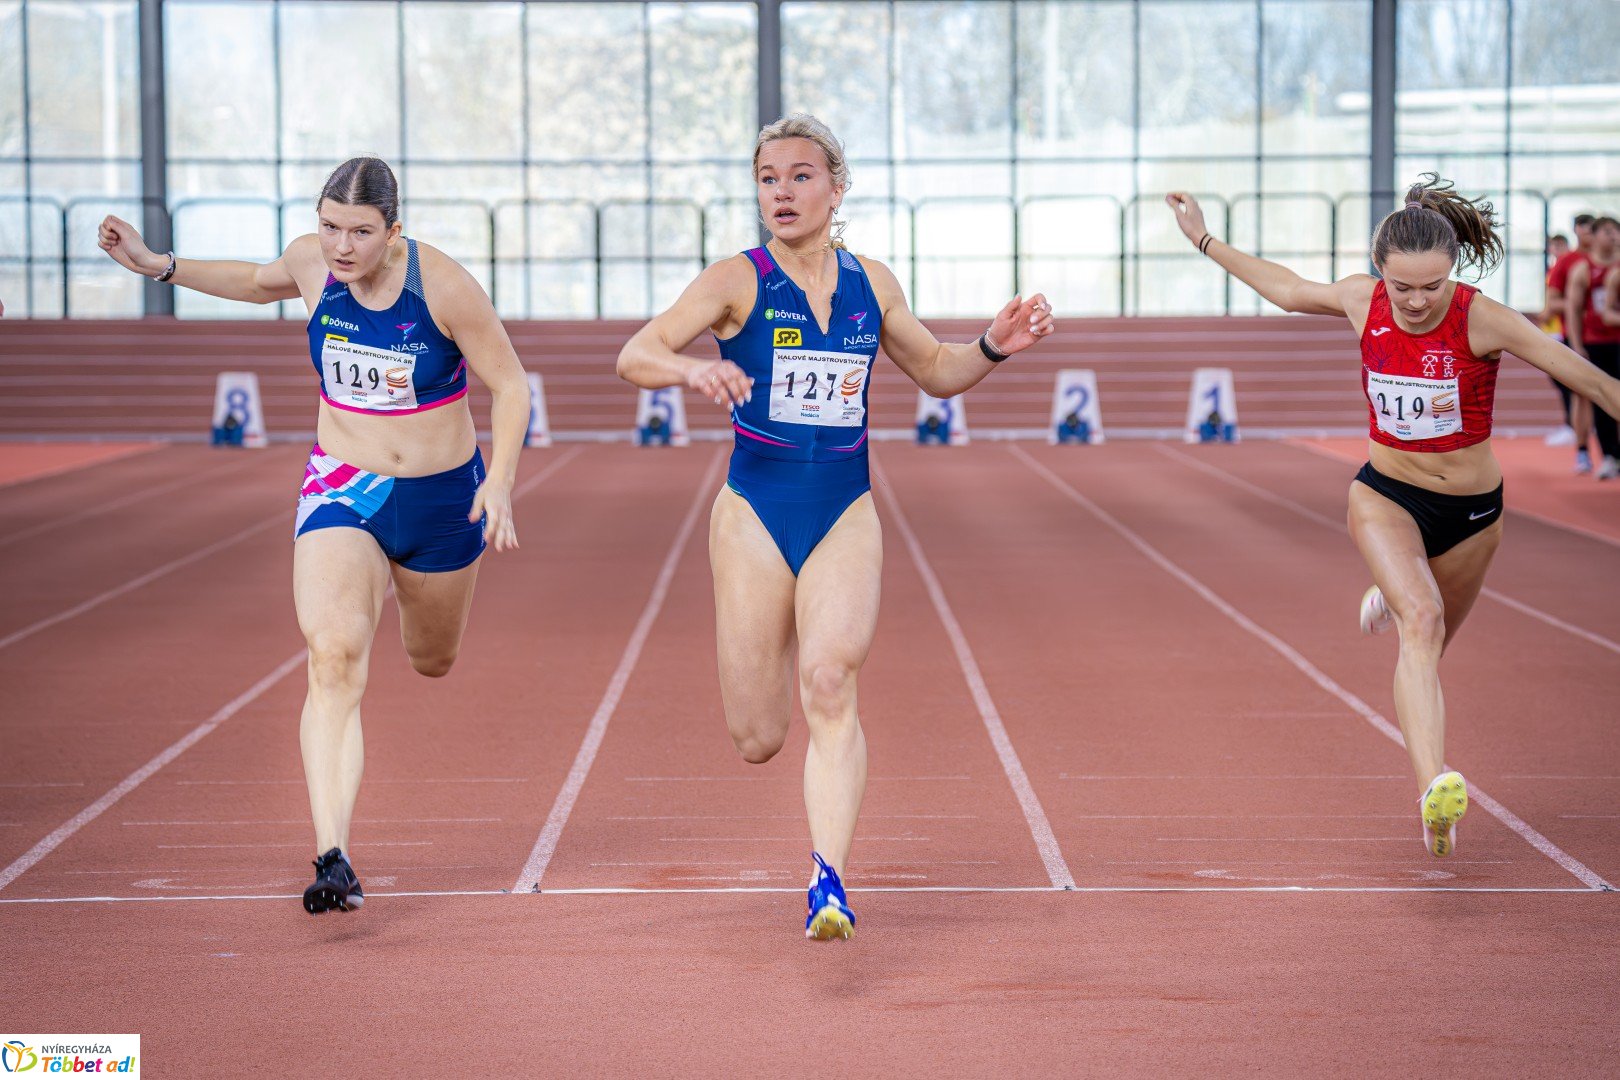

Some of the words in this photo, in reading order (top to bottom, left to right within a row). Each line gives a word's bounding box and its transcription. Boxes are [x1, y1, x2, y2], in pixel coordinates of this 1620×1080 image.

[328, 317, 360, 332] DÔVERA
[774, 309, 808, 322] DÔVERA
[390, 342, 429, 353] NASA
[775, 330, 799, 344] SPP
[843, 334, 878, 346] NASA
[327, 344, 351, 353] HALOVÉ
[403, 357, 413, 365] SR
[332, 360, 380, 390] 129
[784, 371, 837, 401] 127
[226, 387, 250, 427] 8
[1204, 385, 1222, 424] 1
[1376, 392, 1424, 421] 219
